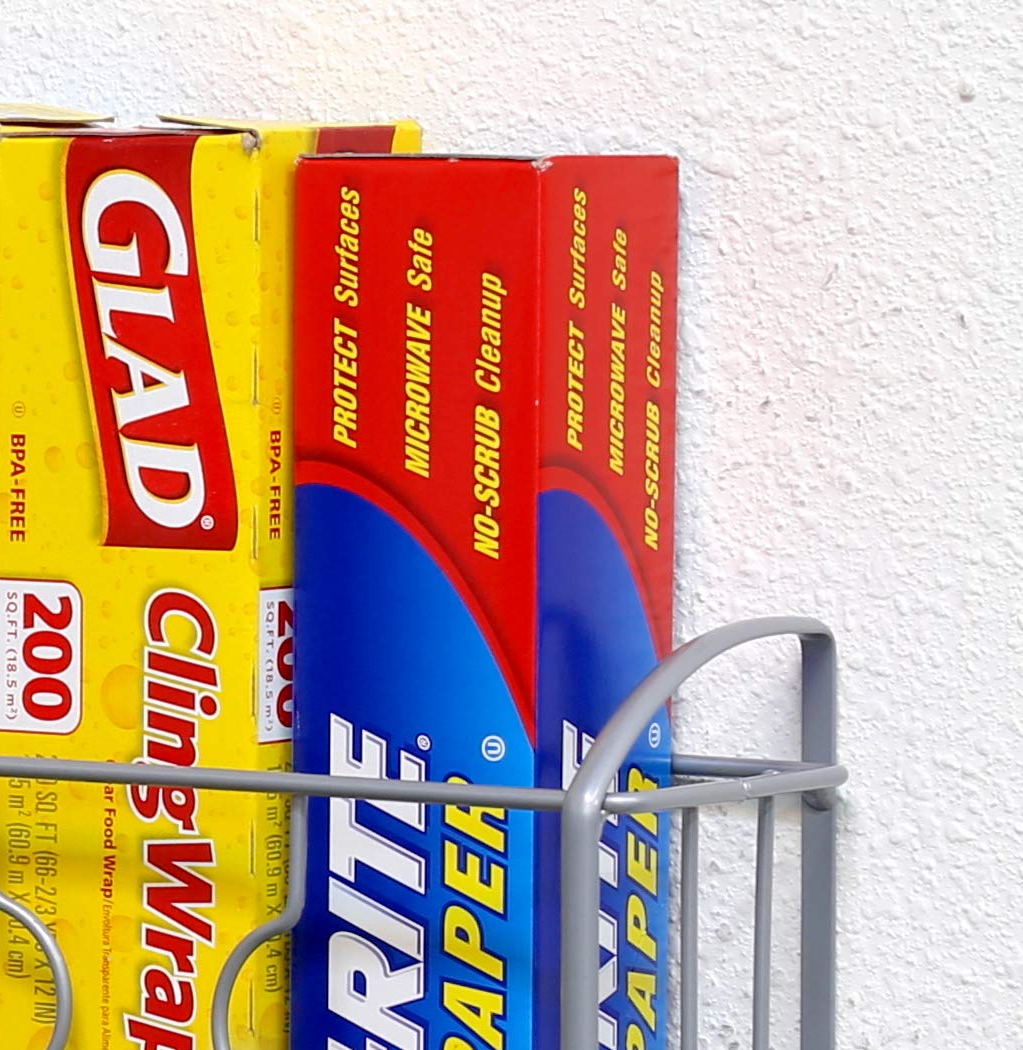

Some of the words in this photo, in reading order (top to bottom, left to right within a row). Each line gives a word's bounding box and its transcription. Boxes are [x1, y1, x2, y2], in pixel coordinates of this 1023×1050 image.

[333, 186, 361, 308] Surfaces
[407, 227, 434, 291] Safe
[568, 188, 588, 309] Surfaces
[611, 229, 628, 291] Safe
[81, 170, 205, 528] GLAD
[333, 317, 358, 449] PROTECT
[474, 272, 509, 393] Cleanup
[566, 321, 584, 451] PROTECT
[609, 303, 626, 476] MICROWAVE
[646, 271, 665, 389] Cleanup
[404, 303, 432, 478] MICROWAVE
[10, 434, 25, 542] BPA-FREE
[269, 430, 282, 540] BPA-FREE
[473, 405, 500, 560] NO-SCRUB
[643, 402, 660, 550] NO-SCRUB
[22, 593, 73, 721] 200
[130, 589, 218, 832] Cling
[6, 823, 31, 865] (60.9
[35, 791, 57, 813] SQ
[35, 822, 57, 843] FT
[103, 808, 116, 850] Food
[9, 870, 25, 884] m
[32, 850, 58, 915] (66-2/3
[5, 951, 31, 979] cm)
